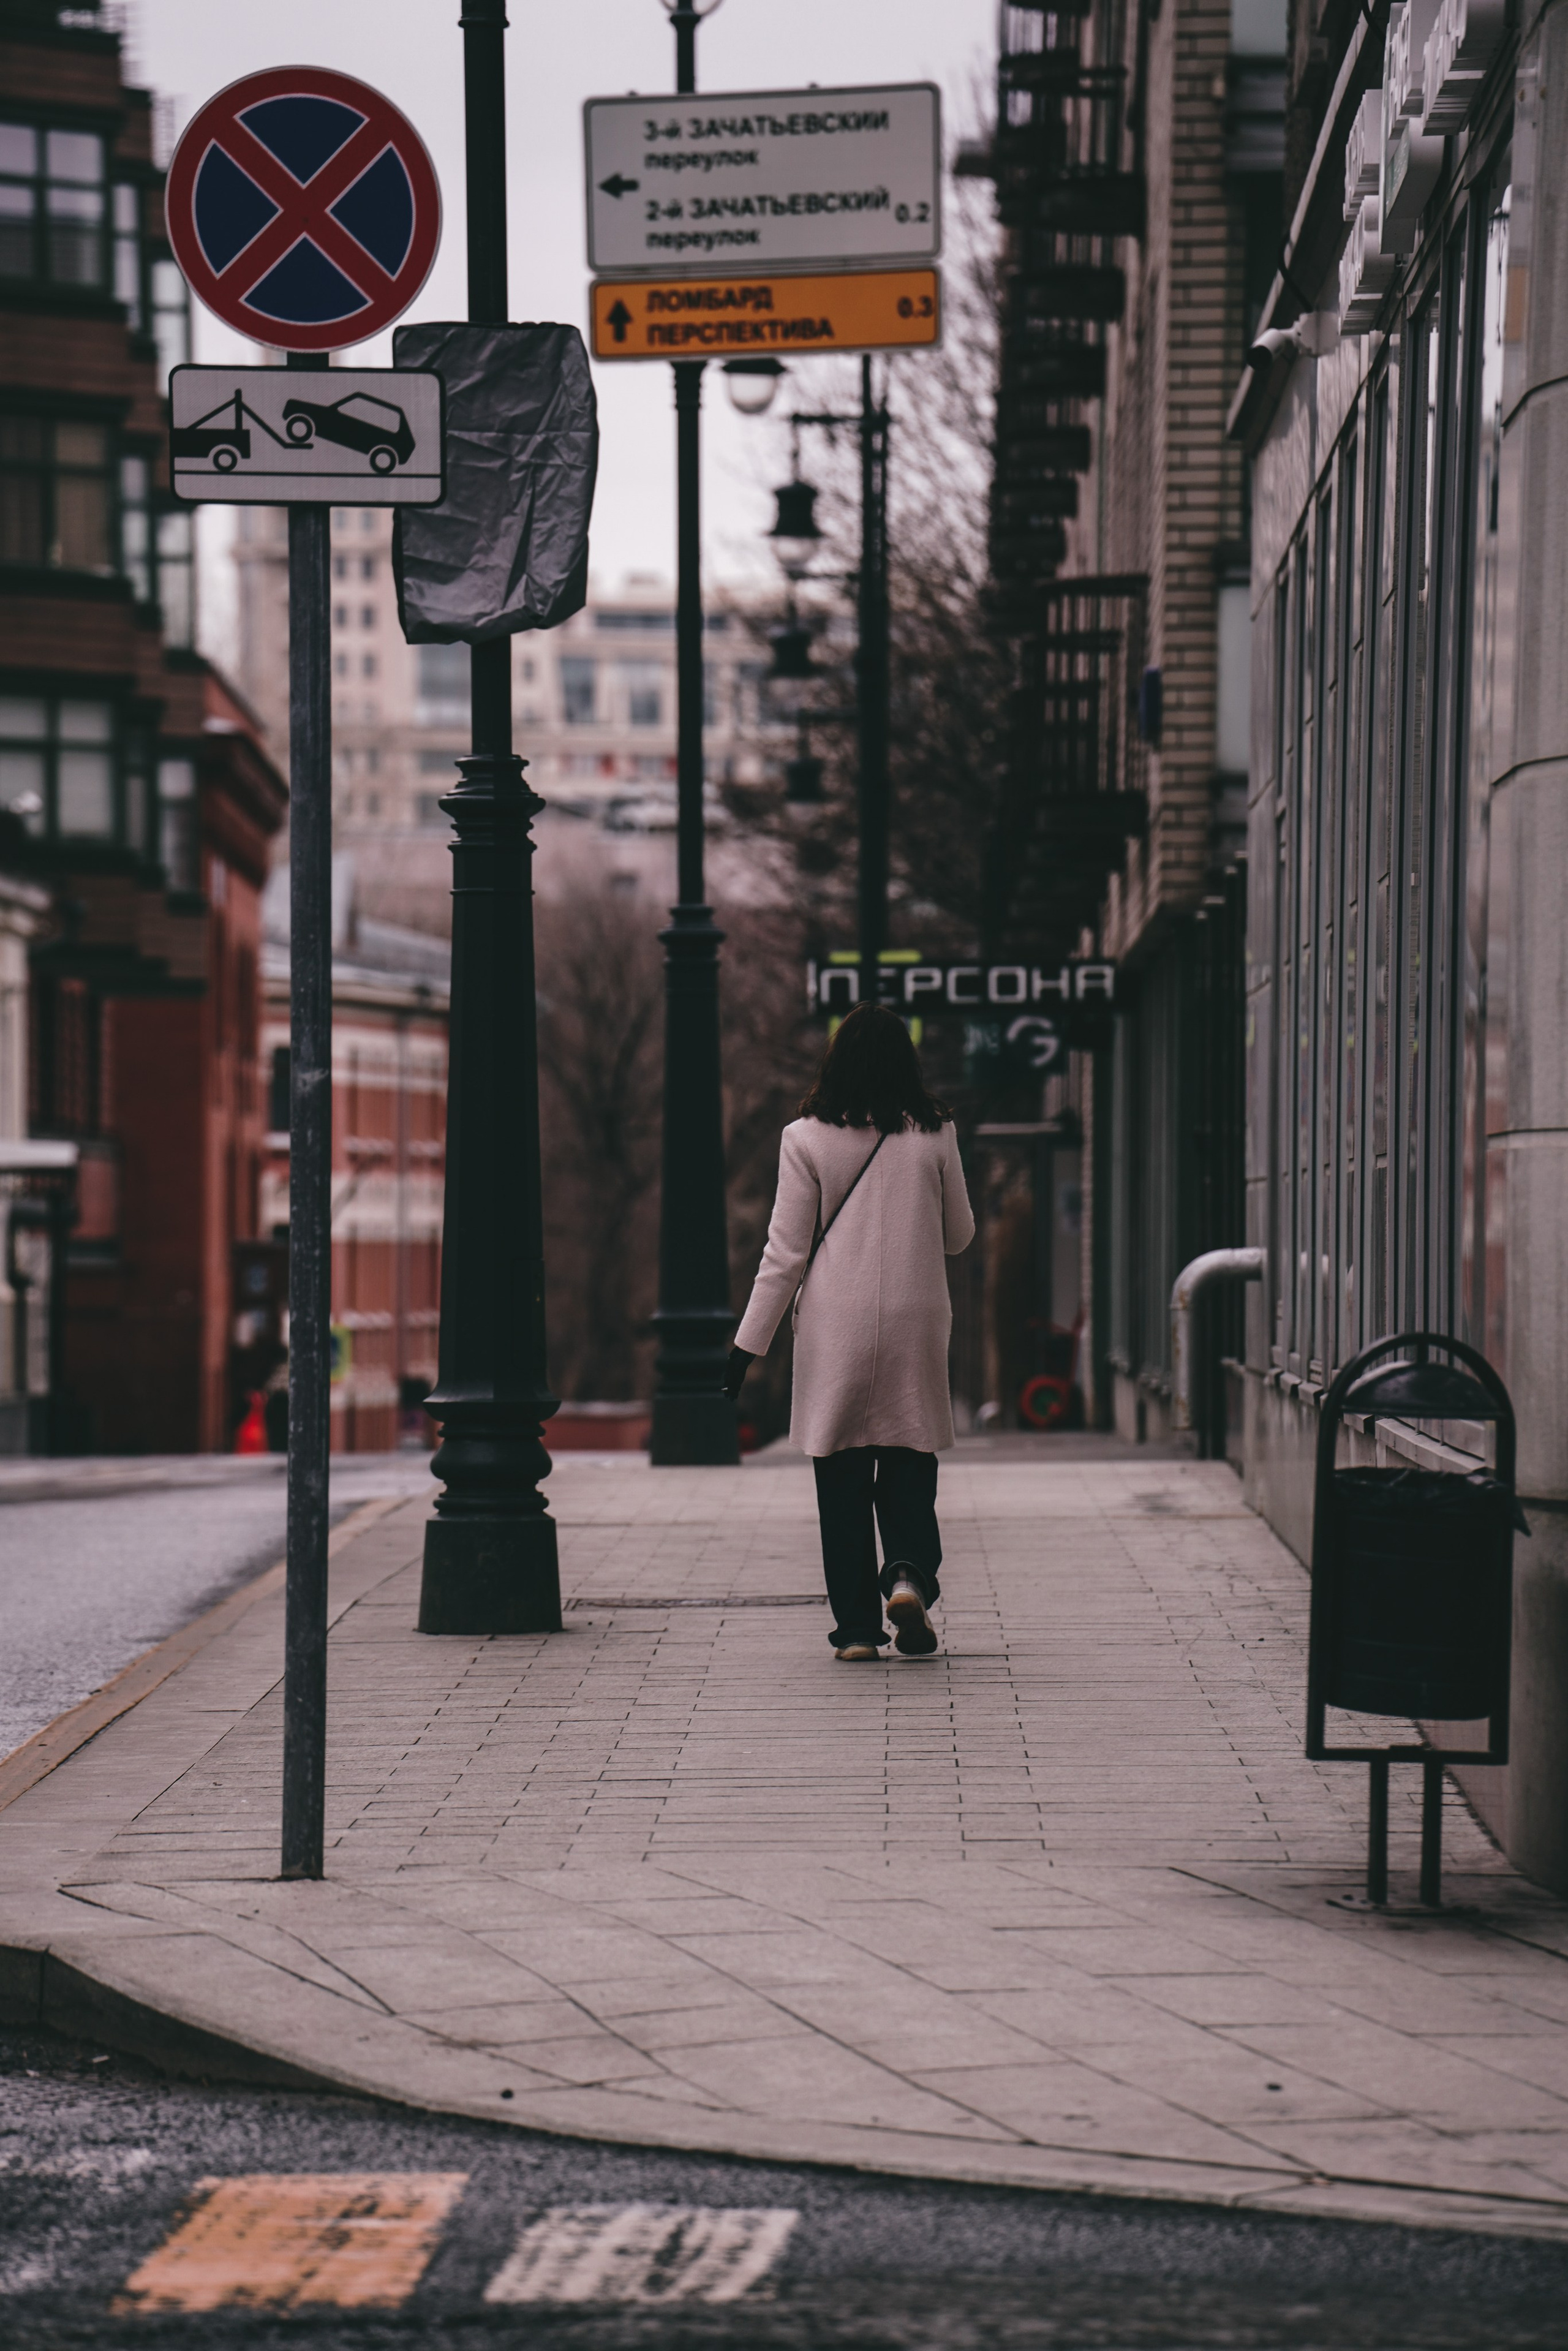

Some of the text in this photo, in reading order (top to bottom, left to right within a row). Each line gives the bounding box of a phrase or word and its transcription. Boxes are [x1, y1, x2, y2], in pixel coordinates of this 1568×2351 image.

[644, 118, 682, 142] 3-й
[644, 149, 759, 173] переулок
[646, 186, 890, 221] 2-й ЗАЧАТЬЕВСКИЙ
[894, 201, 930, 224] 0.2
[646, 228, 760, 252] переулок
[647, 317, 834, 345] ПЕРСПЕКТИВА
